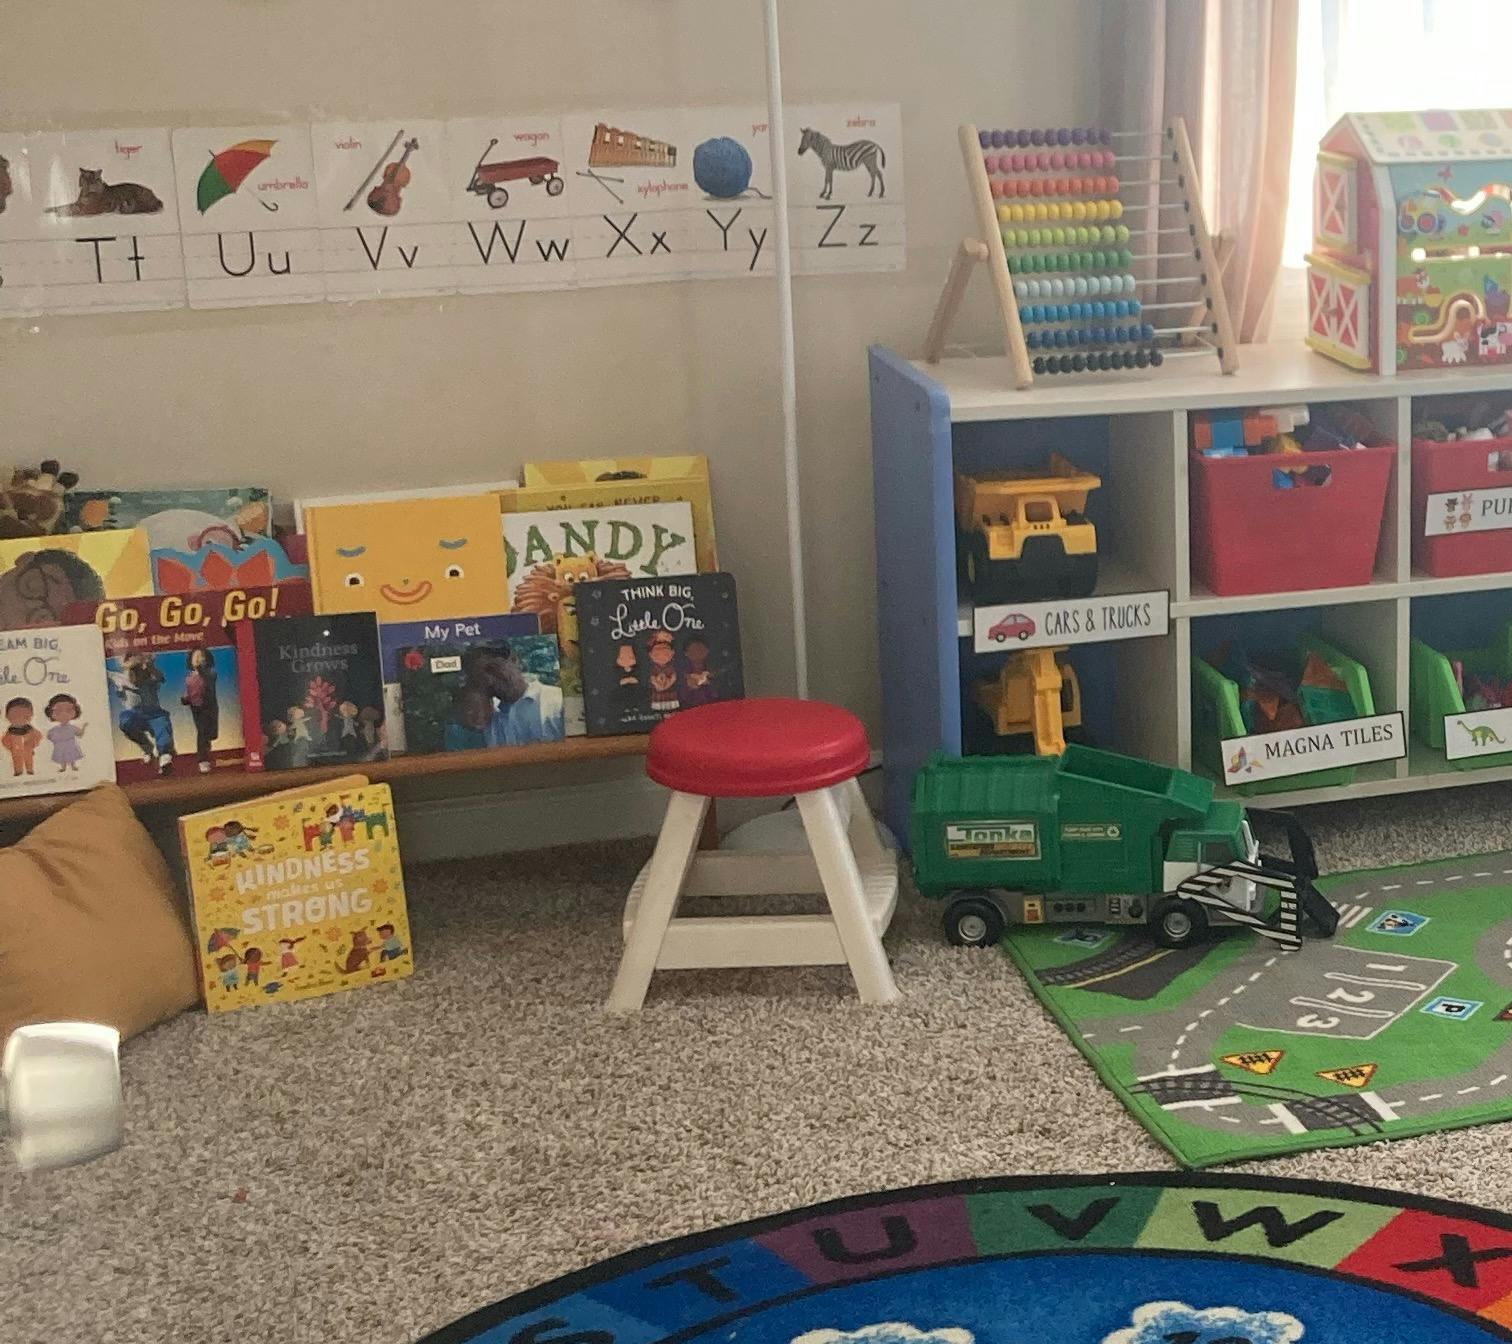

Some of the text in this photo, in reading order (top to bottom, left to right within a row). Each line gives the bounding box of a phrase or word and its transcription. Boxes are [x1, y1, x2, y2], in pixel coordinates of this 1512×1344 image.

[846, 116, 876, 129] zebra
[335, 136, 362, 151] violin
[513, 130, 550, 147] wagon
[114, 140, 143, 159] tiger
[257, 176, 309, 192] umbrella
[637, 180, 689, 199] xylophone
[218, 231, 291, 276] Uu
[356, 226, 418, 271] Vv
[76, 236, 145, 283] Tt
[621, 585, 664, 601] THINK
[95, 587, 280, 634] Go, Go, Go!
[609, 602, 705, 640] Little One
[1044, 603, 1152, 638] CARS & TRUCKS
[134, 636, 148, 647] on
[152, 633, 171, 645] the
[424, 622, 481, 641] My Pet
[278, 642, 358, 660] Kindness
[24, 657, 70, 686] One
[291, 658, 349, 673] Grows
[435, 660, 457, 669] Dad
[1264, 724, 1394, 761] MAGNA TILES
[957, 825, 1033, 842] Tonka
[235, 848, 370, 896] KINDNESS
[266, 878, 344, 902] makes us
[241, 887, 373, 935] STRONG
[1366, 962, 1408, 972] 1
[1326, 987, 1375, 1004] 2
[1296, 1013, 1341, 1029] 3
[1027, 1198, 1121, 1240] V
[1194, 1202, 1344, 1248] W
[814, 1216, 918, 1264] U
[649, 1258, 744, 1304] T
